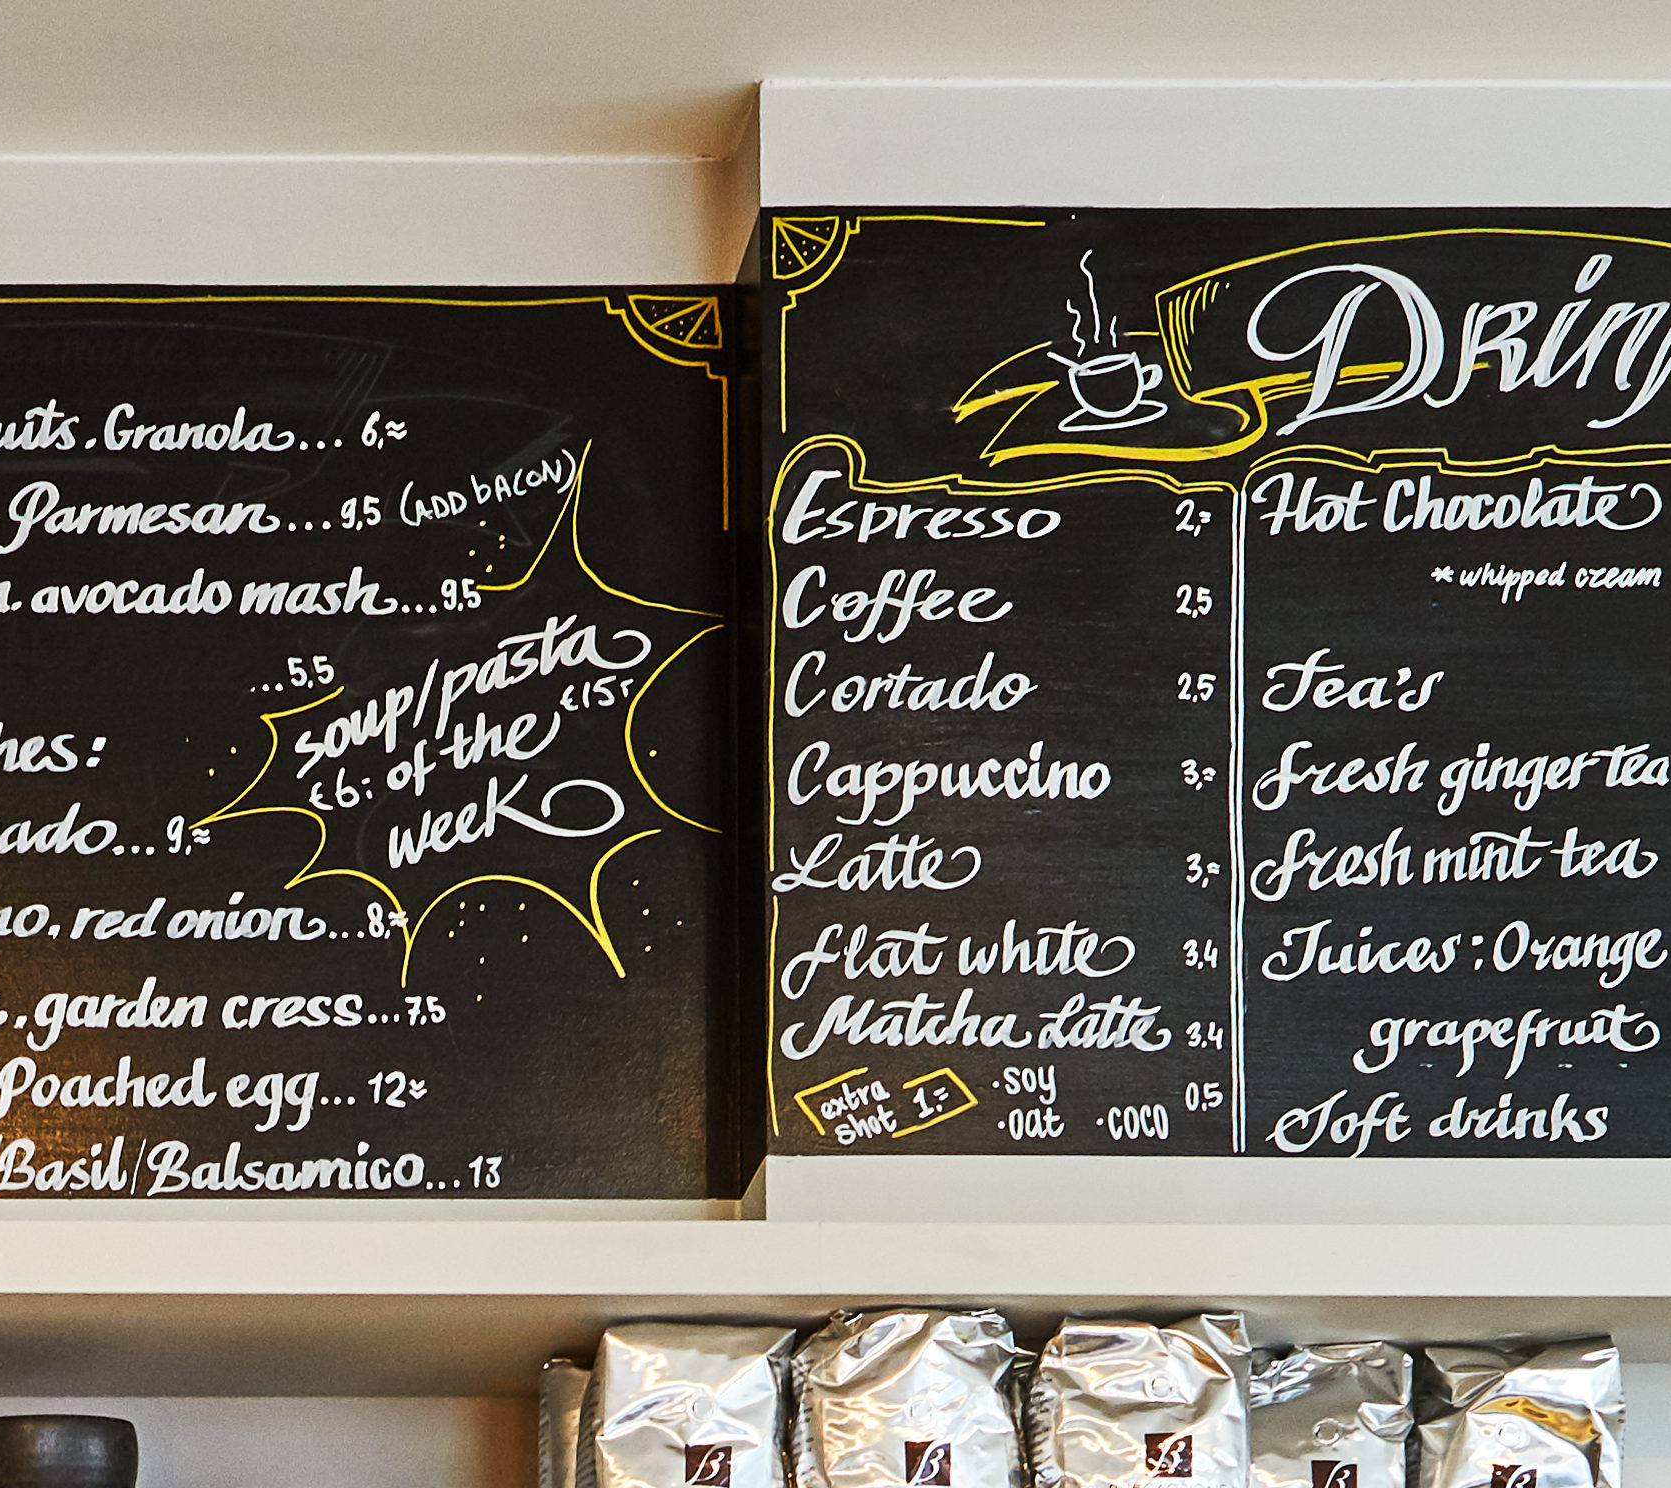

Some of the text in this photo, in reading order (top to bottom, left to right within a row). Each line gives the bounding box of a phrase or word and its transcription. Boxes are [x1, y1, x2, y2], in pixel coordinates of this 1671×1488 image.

[782, 469, 1062, 545] Espresso
[1250, 471, 1663, 536] Hot Chocolate
[30, 567, 233, 615] avocado
[782, 565, 1213, 644] Coffee 2,5
[1459, 561, 1568, 605] whipped
[1574, 566, 1662, 589] cream
[784, 650, 1217, 718] Cortado 2,5
[386, 710, 561, 797] of the
[787, 740, 1112, 827] Cappuccino
[1437, 742, 1601, 817] ginger
[1591, 743, 1670, 788] tea
[771, 832, 982, 893] Latte
[1422, 825, 1553, 885] mint
[1549, 826, 1659, 879] tea
[69, 897, 167, 940] red
[958, 918, 1136, 978] white
[1492, 920, 1669, 989] Orange
[26, 976, 208, 1052] garden
[779, 987, 1033, 1061] Matcha
[1037, 992, 1172, 1052] Latte
[1352, 1003, 1660, 1080] grapefruit
[820, 1080, 891, 1121] extra
[834, 1103, 898, 1146] shot
[1264, 1089, 1609, 1153] Soft drinks
[468, 1155, 503, 1189] 13
